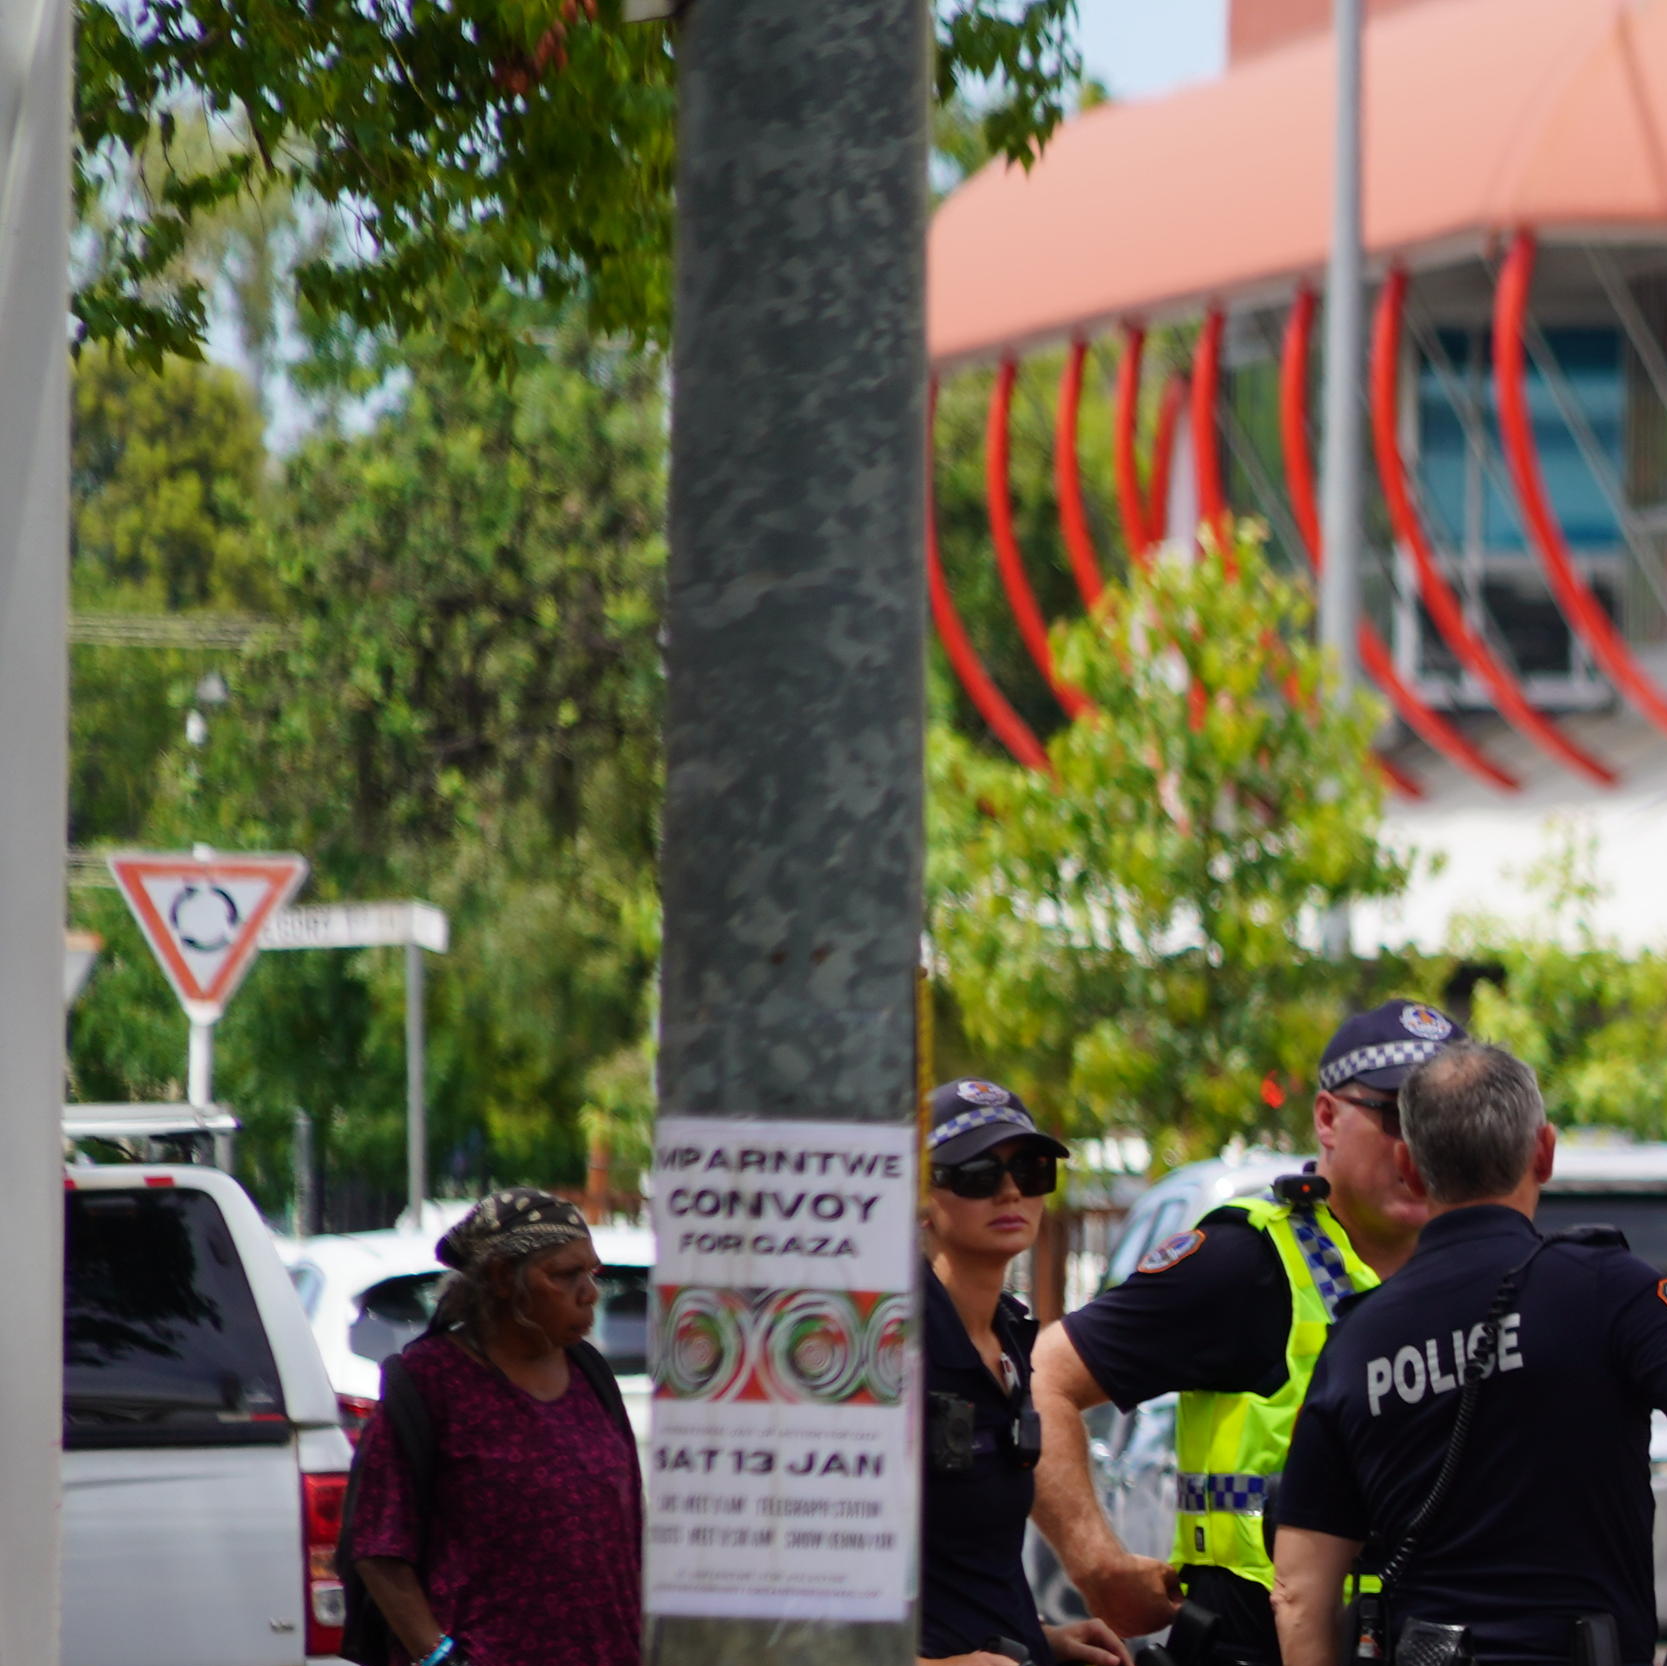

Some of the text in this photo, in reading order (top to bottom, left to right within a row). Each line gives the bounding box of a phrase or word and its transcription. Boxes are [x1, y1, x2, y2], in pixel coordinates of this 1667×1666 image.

[669, 1187, 880, 1222] CONVOY
[680, 1233, 856, 1257] FOR GAZA
[1367, 1312, 1524, 1417] POLICE
[655, 1447, 884, 1479] SAT 13 JAN
